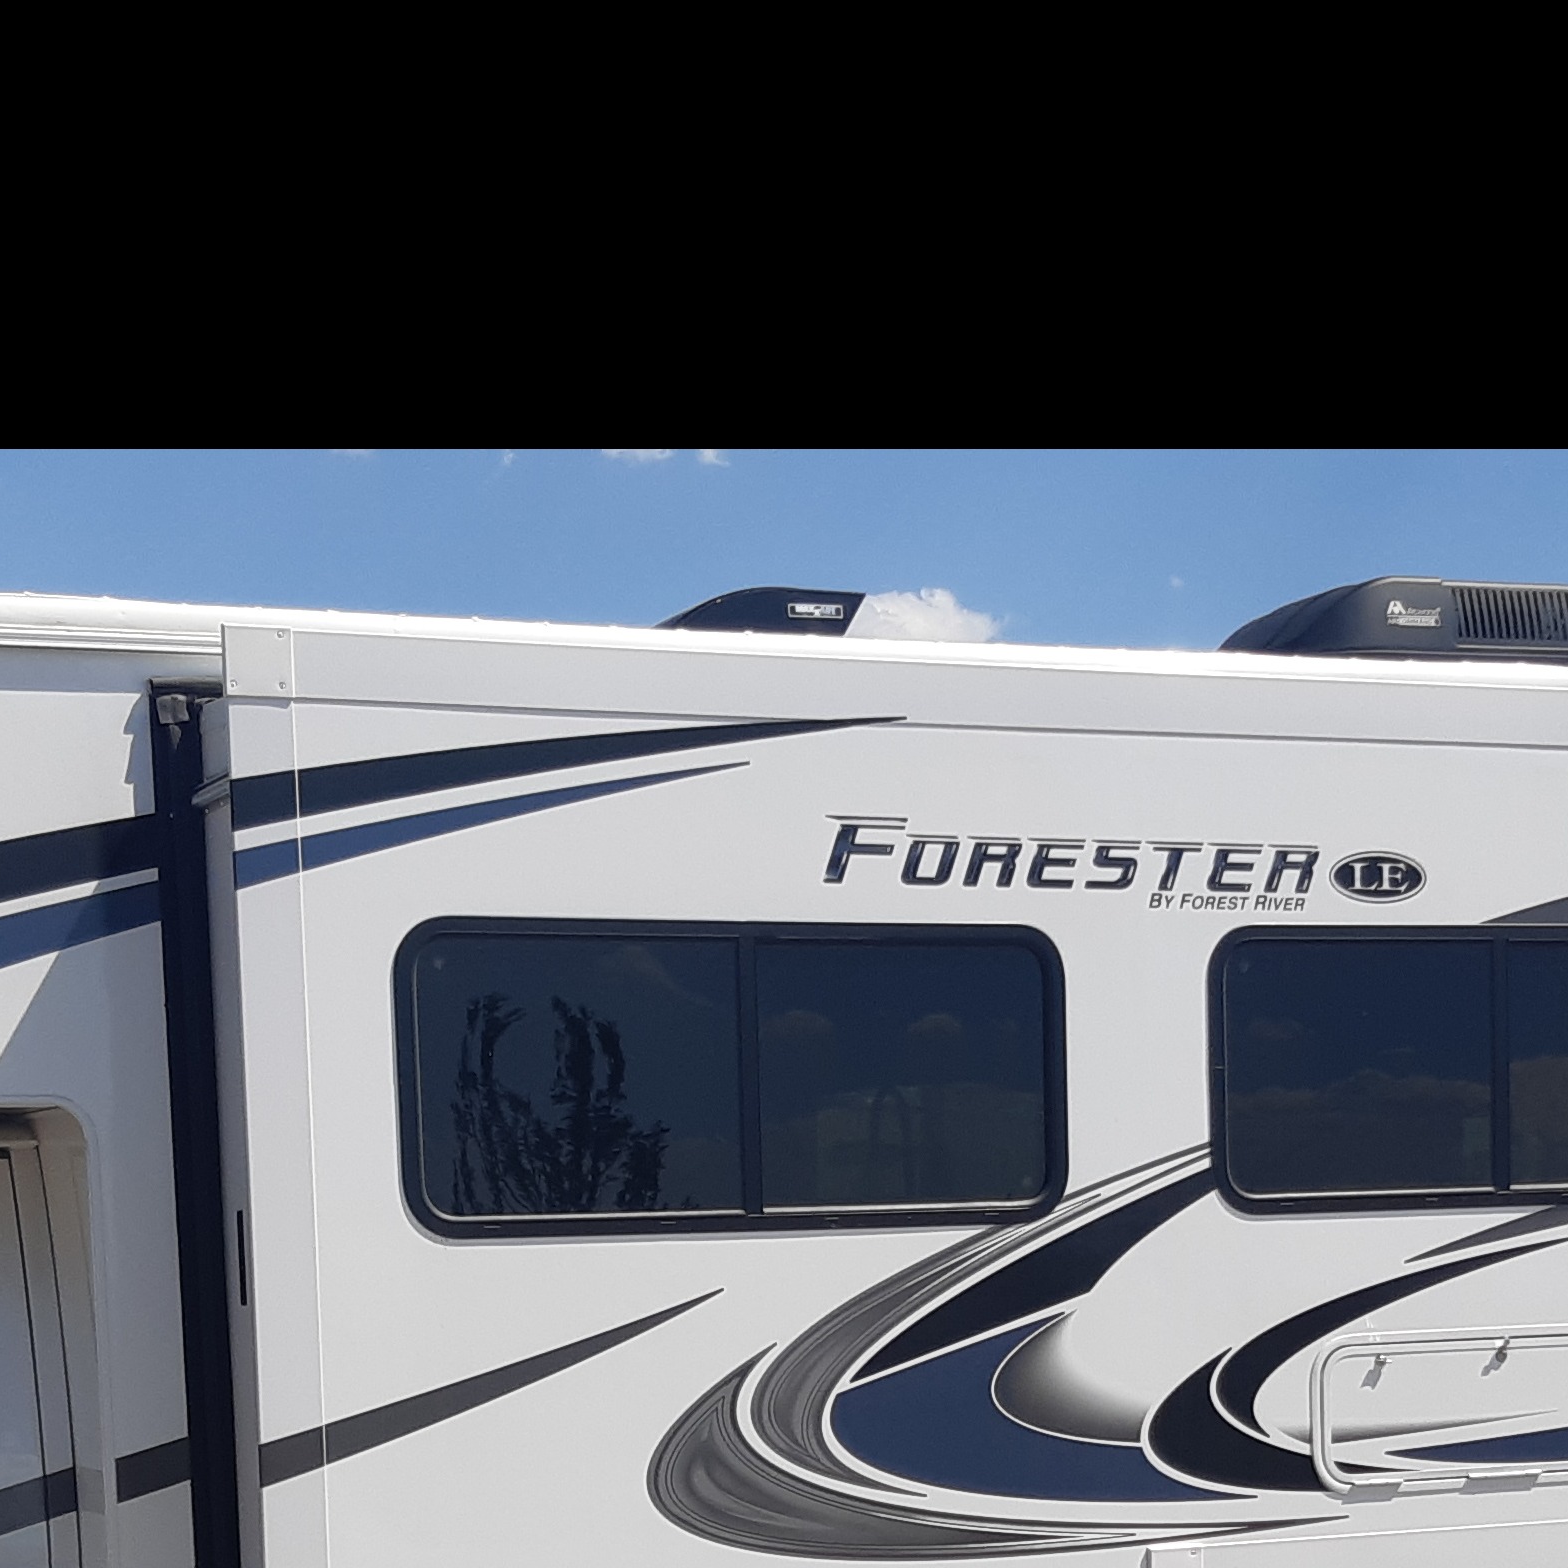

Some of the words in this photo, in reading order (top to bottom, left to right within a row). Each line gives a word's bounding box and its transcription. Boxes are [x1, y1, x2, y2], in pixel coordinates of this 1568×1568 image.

[822, 814, 1321, 895] FORESTER
[1346, 861, 1410, 894] LE
[1148, 892, 1175, 909] BY
[1179, 893, 1250, 911] FOREST
[1253, 894, 1306, 912] RIVER
